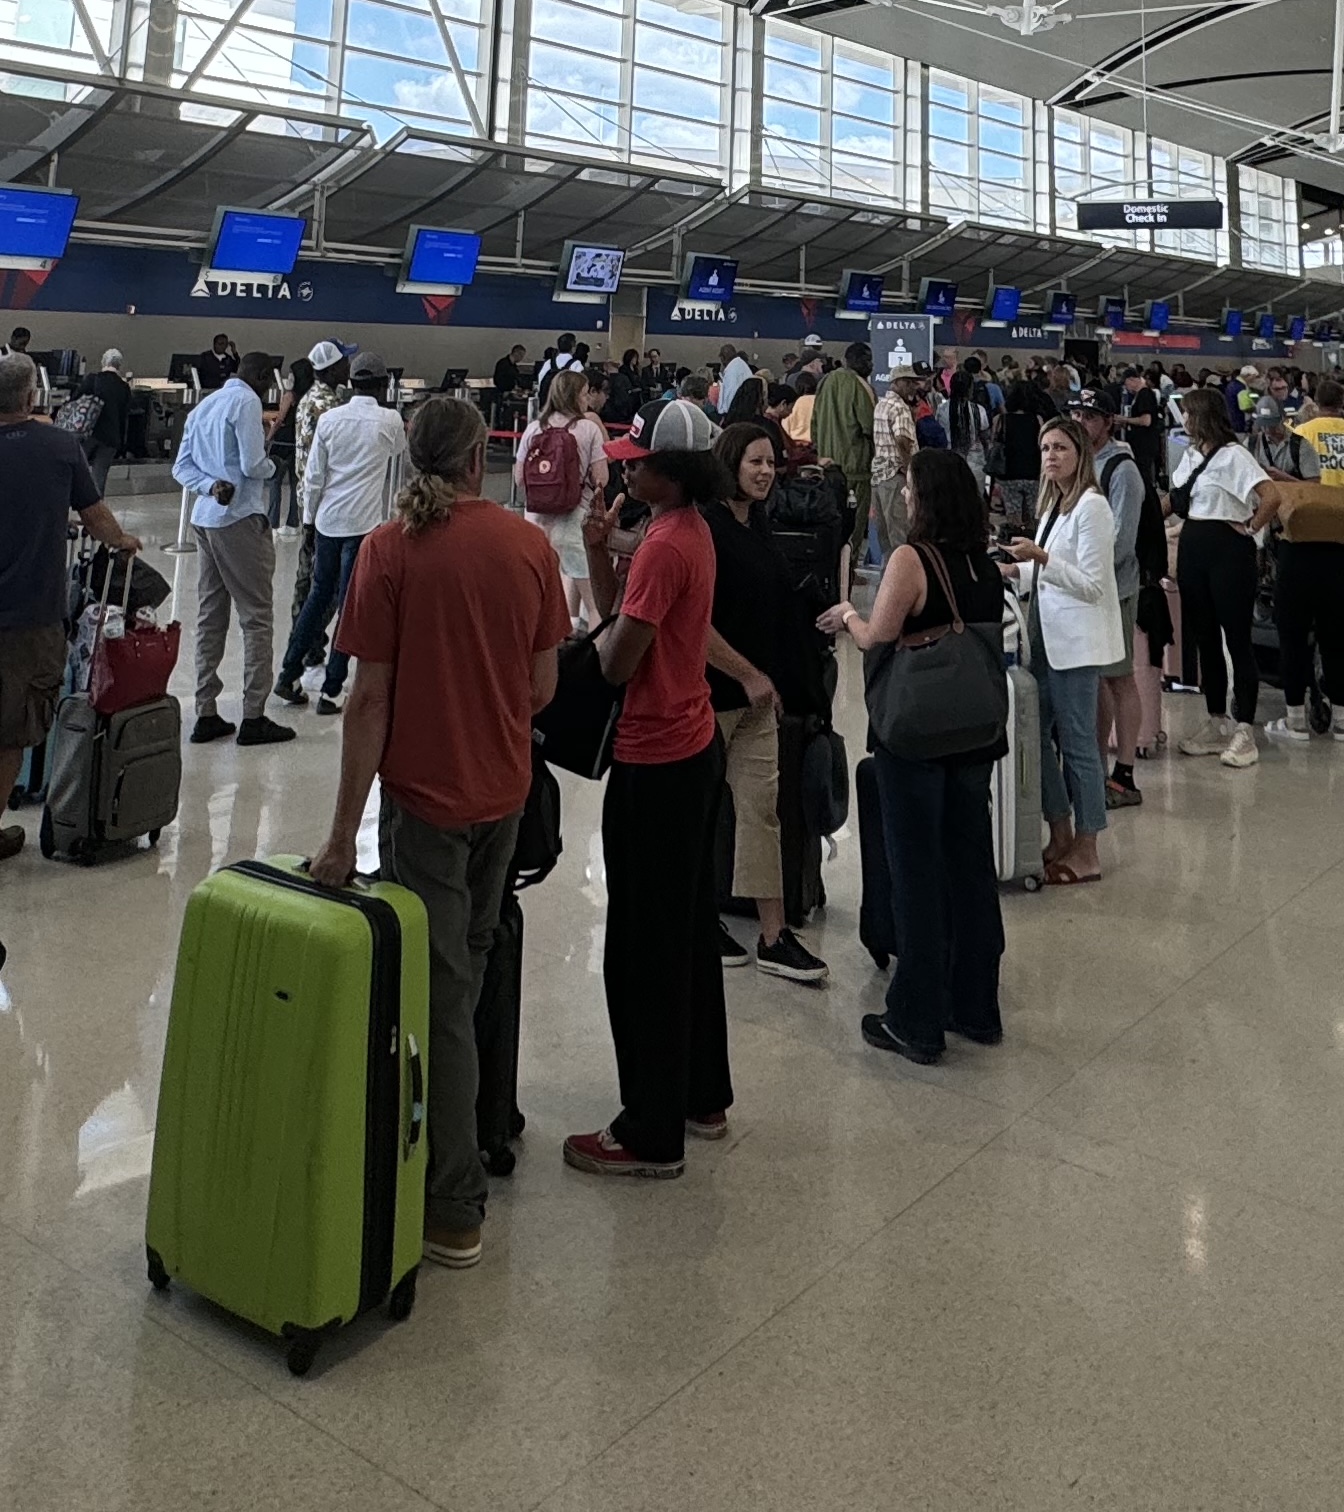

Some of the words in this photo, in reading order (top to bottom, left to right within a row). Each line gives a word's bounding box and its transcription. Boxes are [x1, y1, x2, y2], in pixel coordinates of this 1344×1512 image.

[1123, 204, 1169, 214] Domestic
[1125, 214, 1155, 223] Check
[217, 281, 292, 299] DELTA
[684, 307, 726, 321] DELTA
[885, 321, 916, 330] DELTA
[1018, 326, 1042, 338] DELTA
